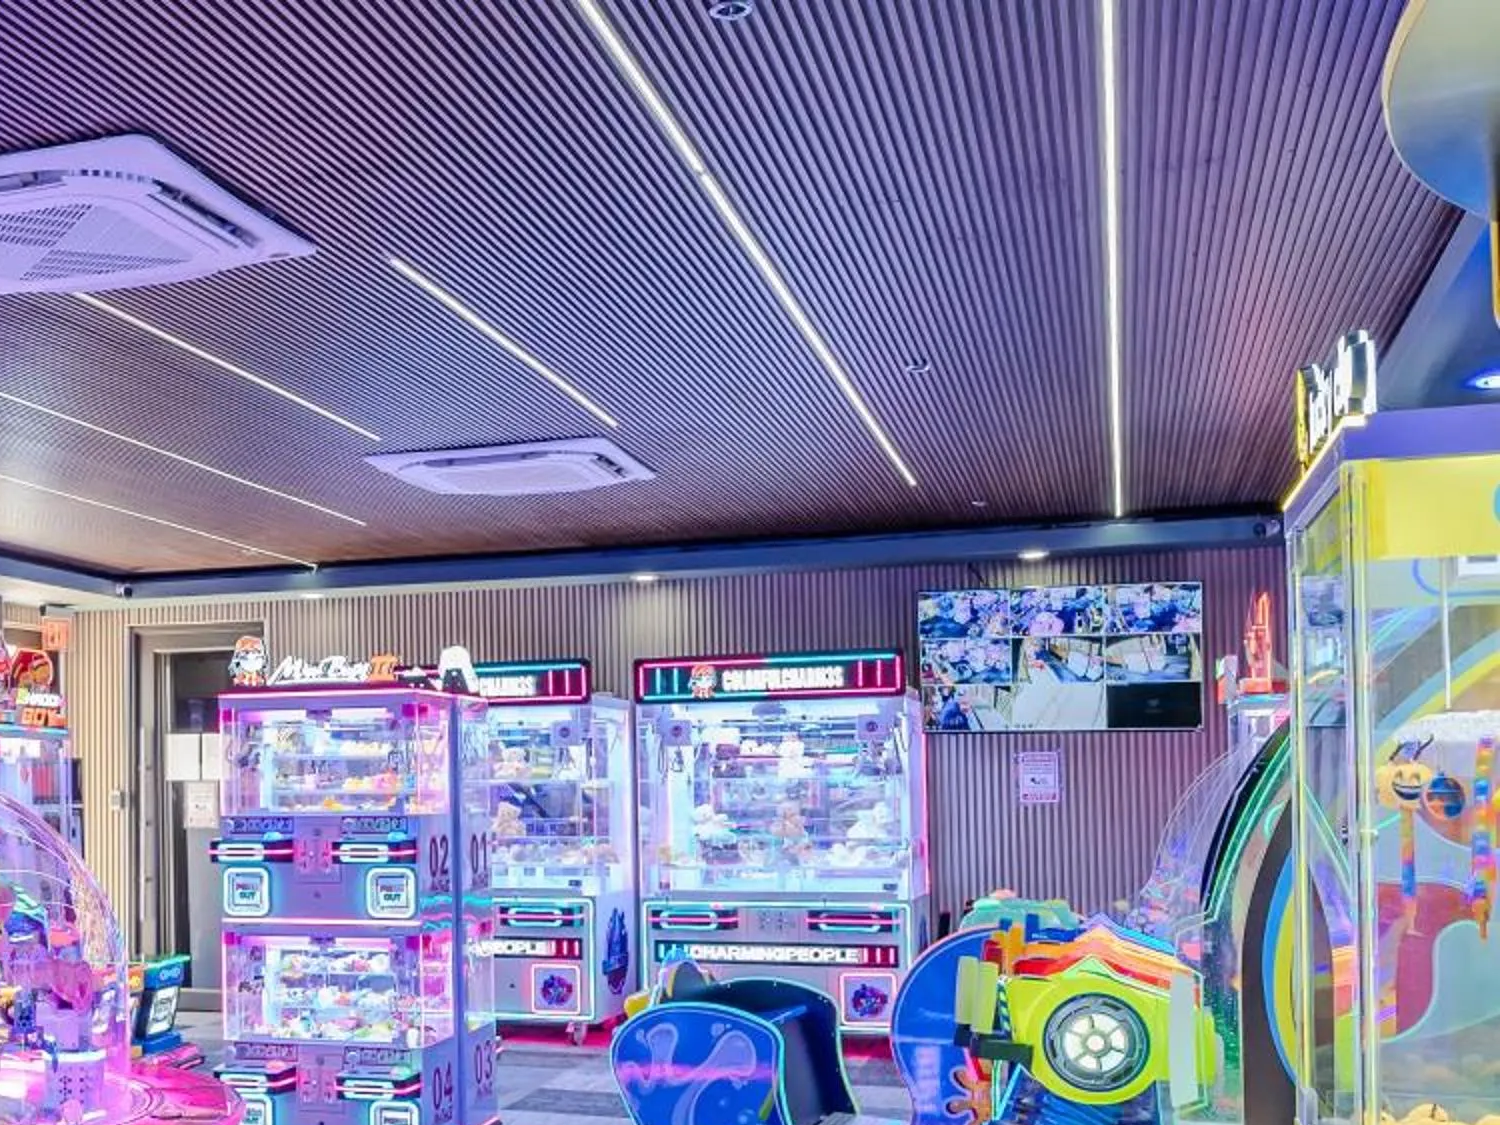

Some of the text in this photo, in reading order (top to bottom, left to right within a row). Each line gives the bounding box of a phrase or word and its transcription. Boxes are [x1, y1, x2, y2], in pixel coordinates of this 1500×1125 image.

[429, 833, 450, 878] 02
[470, 832, 489, 874] 01
[474, 1040, 494, 1085] 03
[432, 1061, 453, 1111] 04
